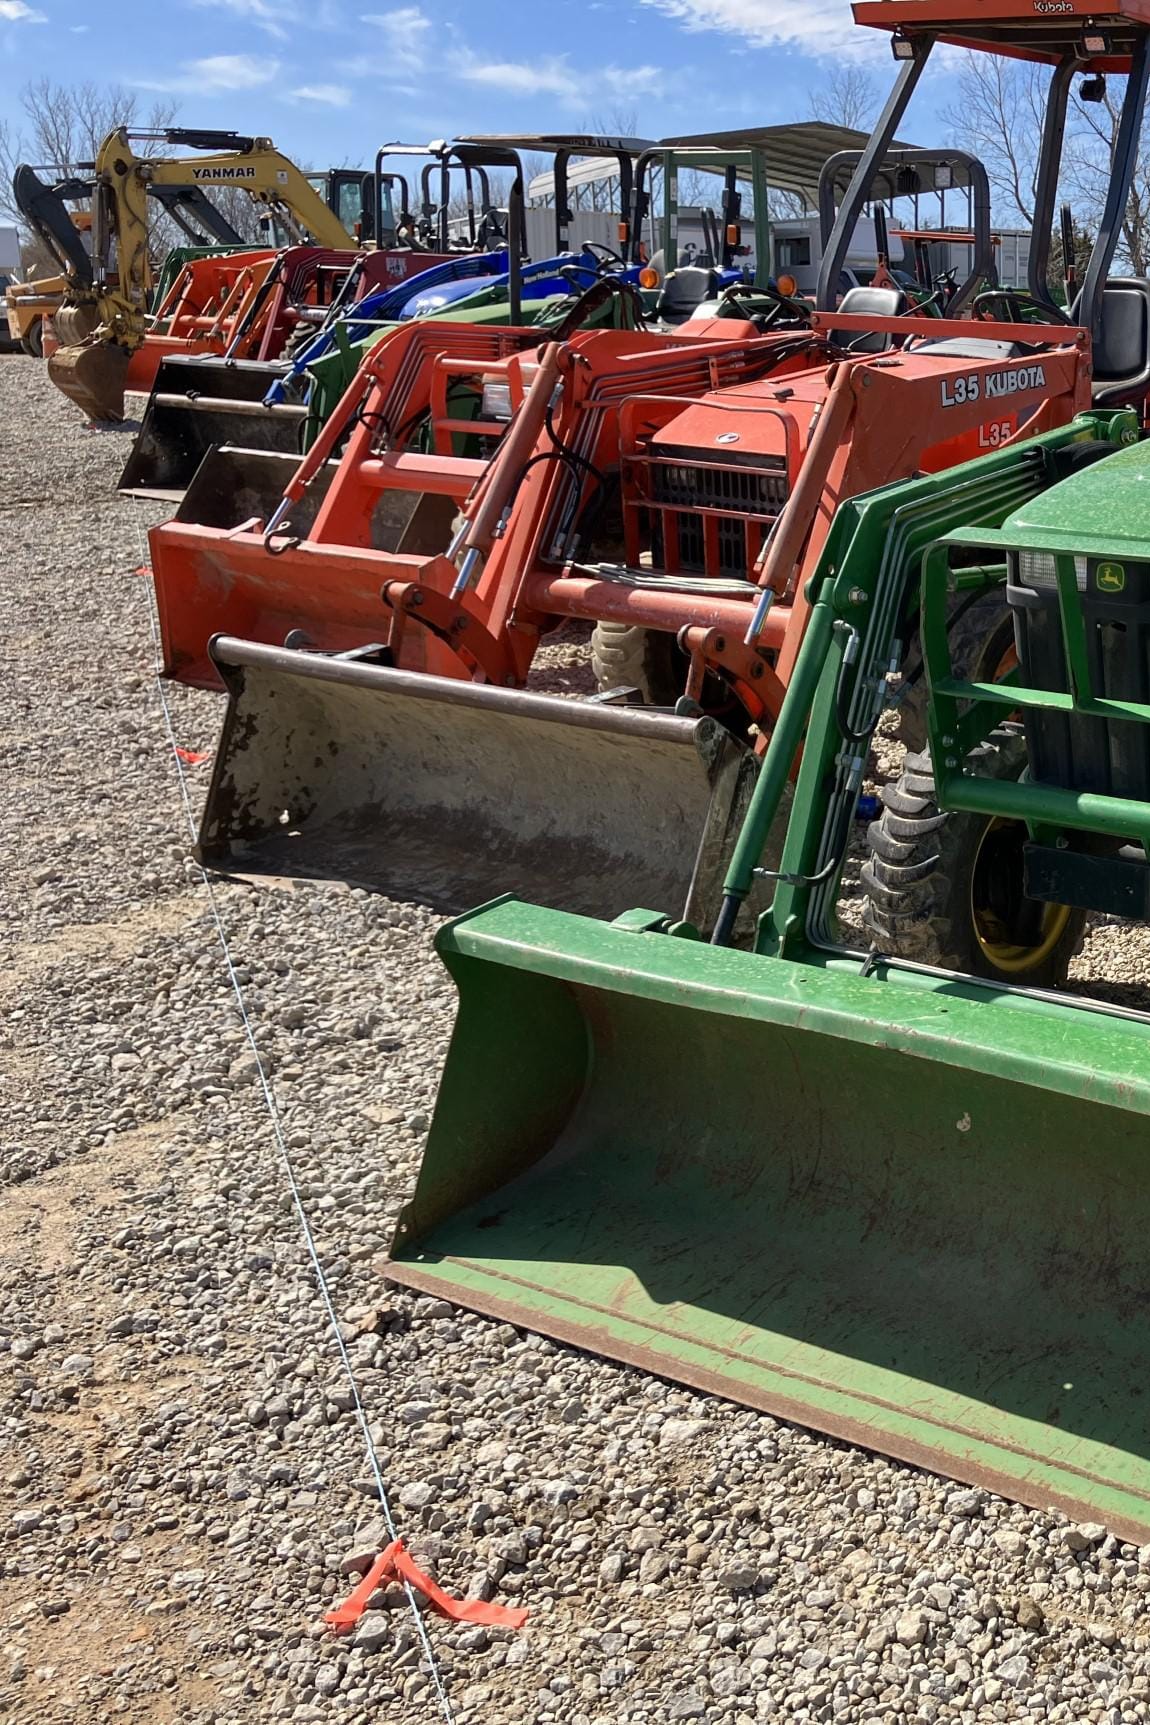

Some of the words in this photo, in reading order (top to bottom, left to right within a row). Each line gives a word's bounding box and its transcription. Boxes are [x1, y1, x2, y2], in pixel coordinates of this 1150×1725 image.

[1033, 1, 1074, 12] Kubota
[192, 167, 255, 178] YANMAR
[941, 375, 980, 407] L35
[985, 366, 1046, 398] KUBOTA
[979, 421, 1012, 447] L35
